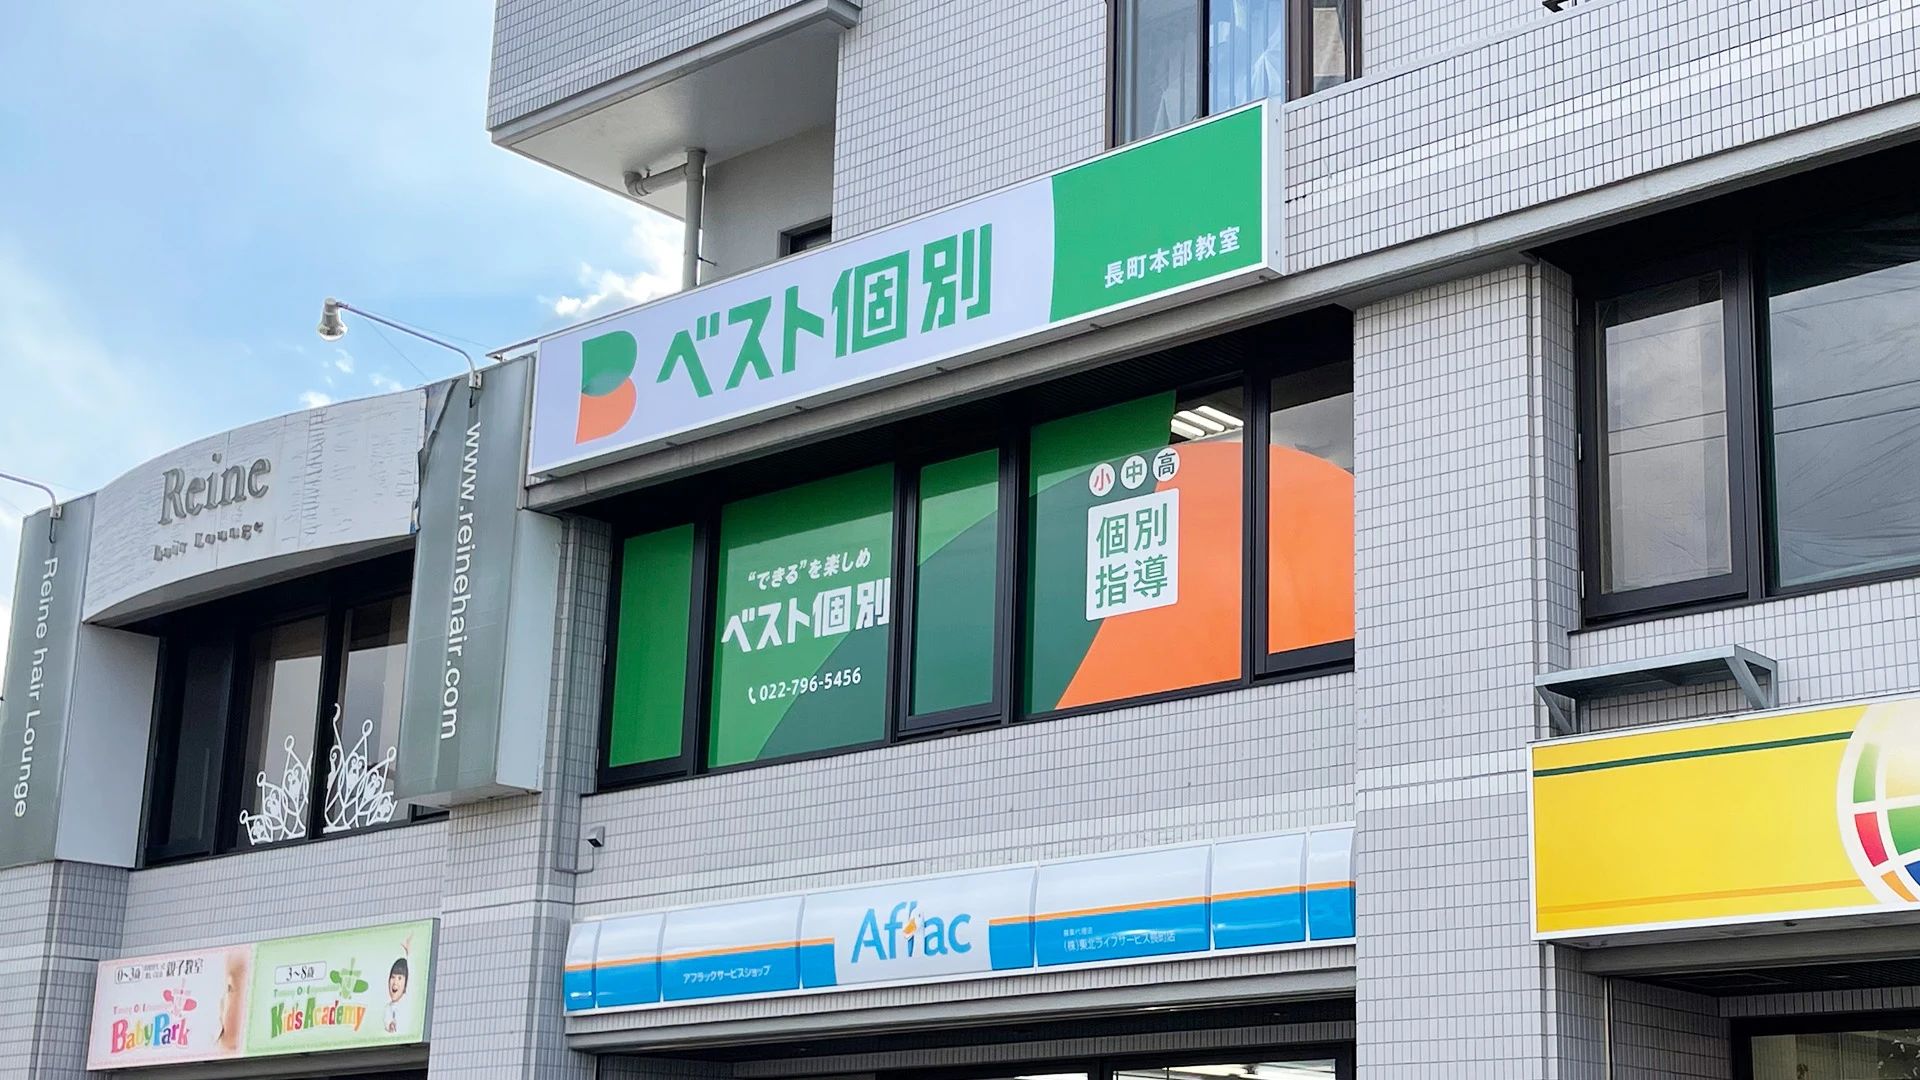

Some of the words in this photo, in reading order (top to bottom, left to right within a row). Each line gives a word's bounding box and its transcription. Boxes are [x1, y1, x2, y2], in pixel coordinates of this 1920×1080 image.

[1104, 226, 1240, 288] 長町本部教室
[656, 223, 992, 398] ベスト個別
[158, 453, 271, 525] Reine
[1096, 503, 1168, 559] 個別
[36, 556, 58, 639] Reine
[440, 421, 482, 740] www.reinehair.com
[1096, 554, 1168, 609] 指導
[721, 577, 891, 653] ベスト個別
[29, 647, 49, 700] hair
[759, 667, 862, 701] 022-796-5456
[14, 710, 41, 818] Lounge
[851, 900, 972, 963] Aflac
[683, 965, 772, 984] アフラックサービスショップ
